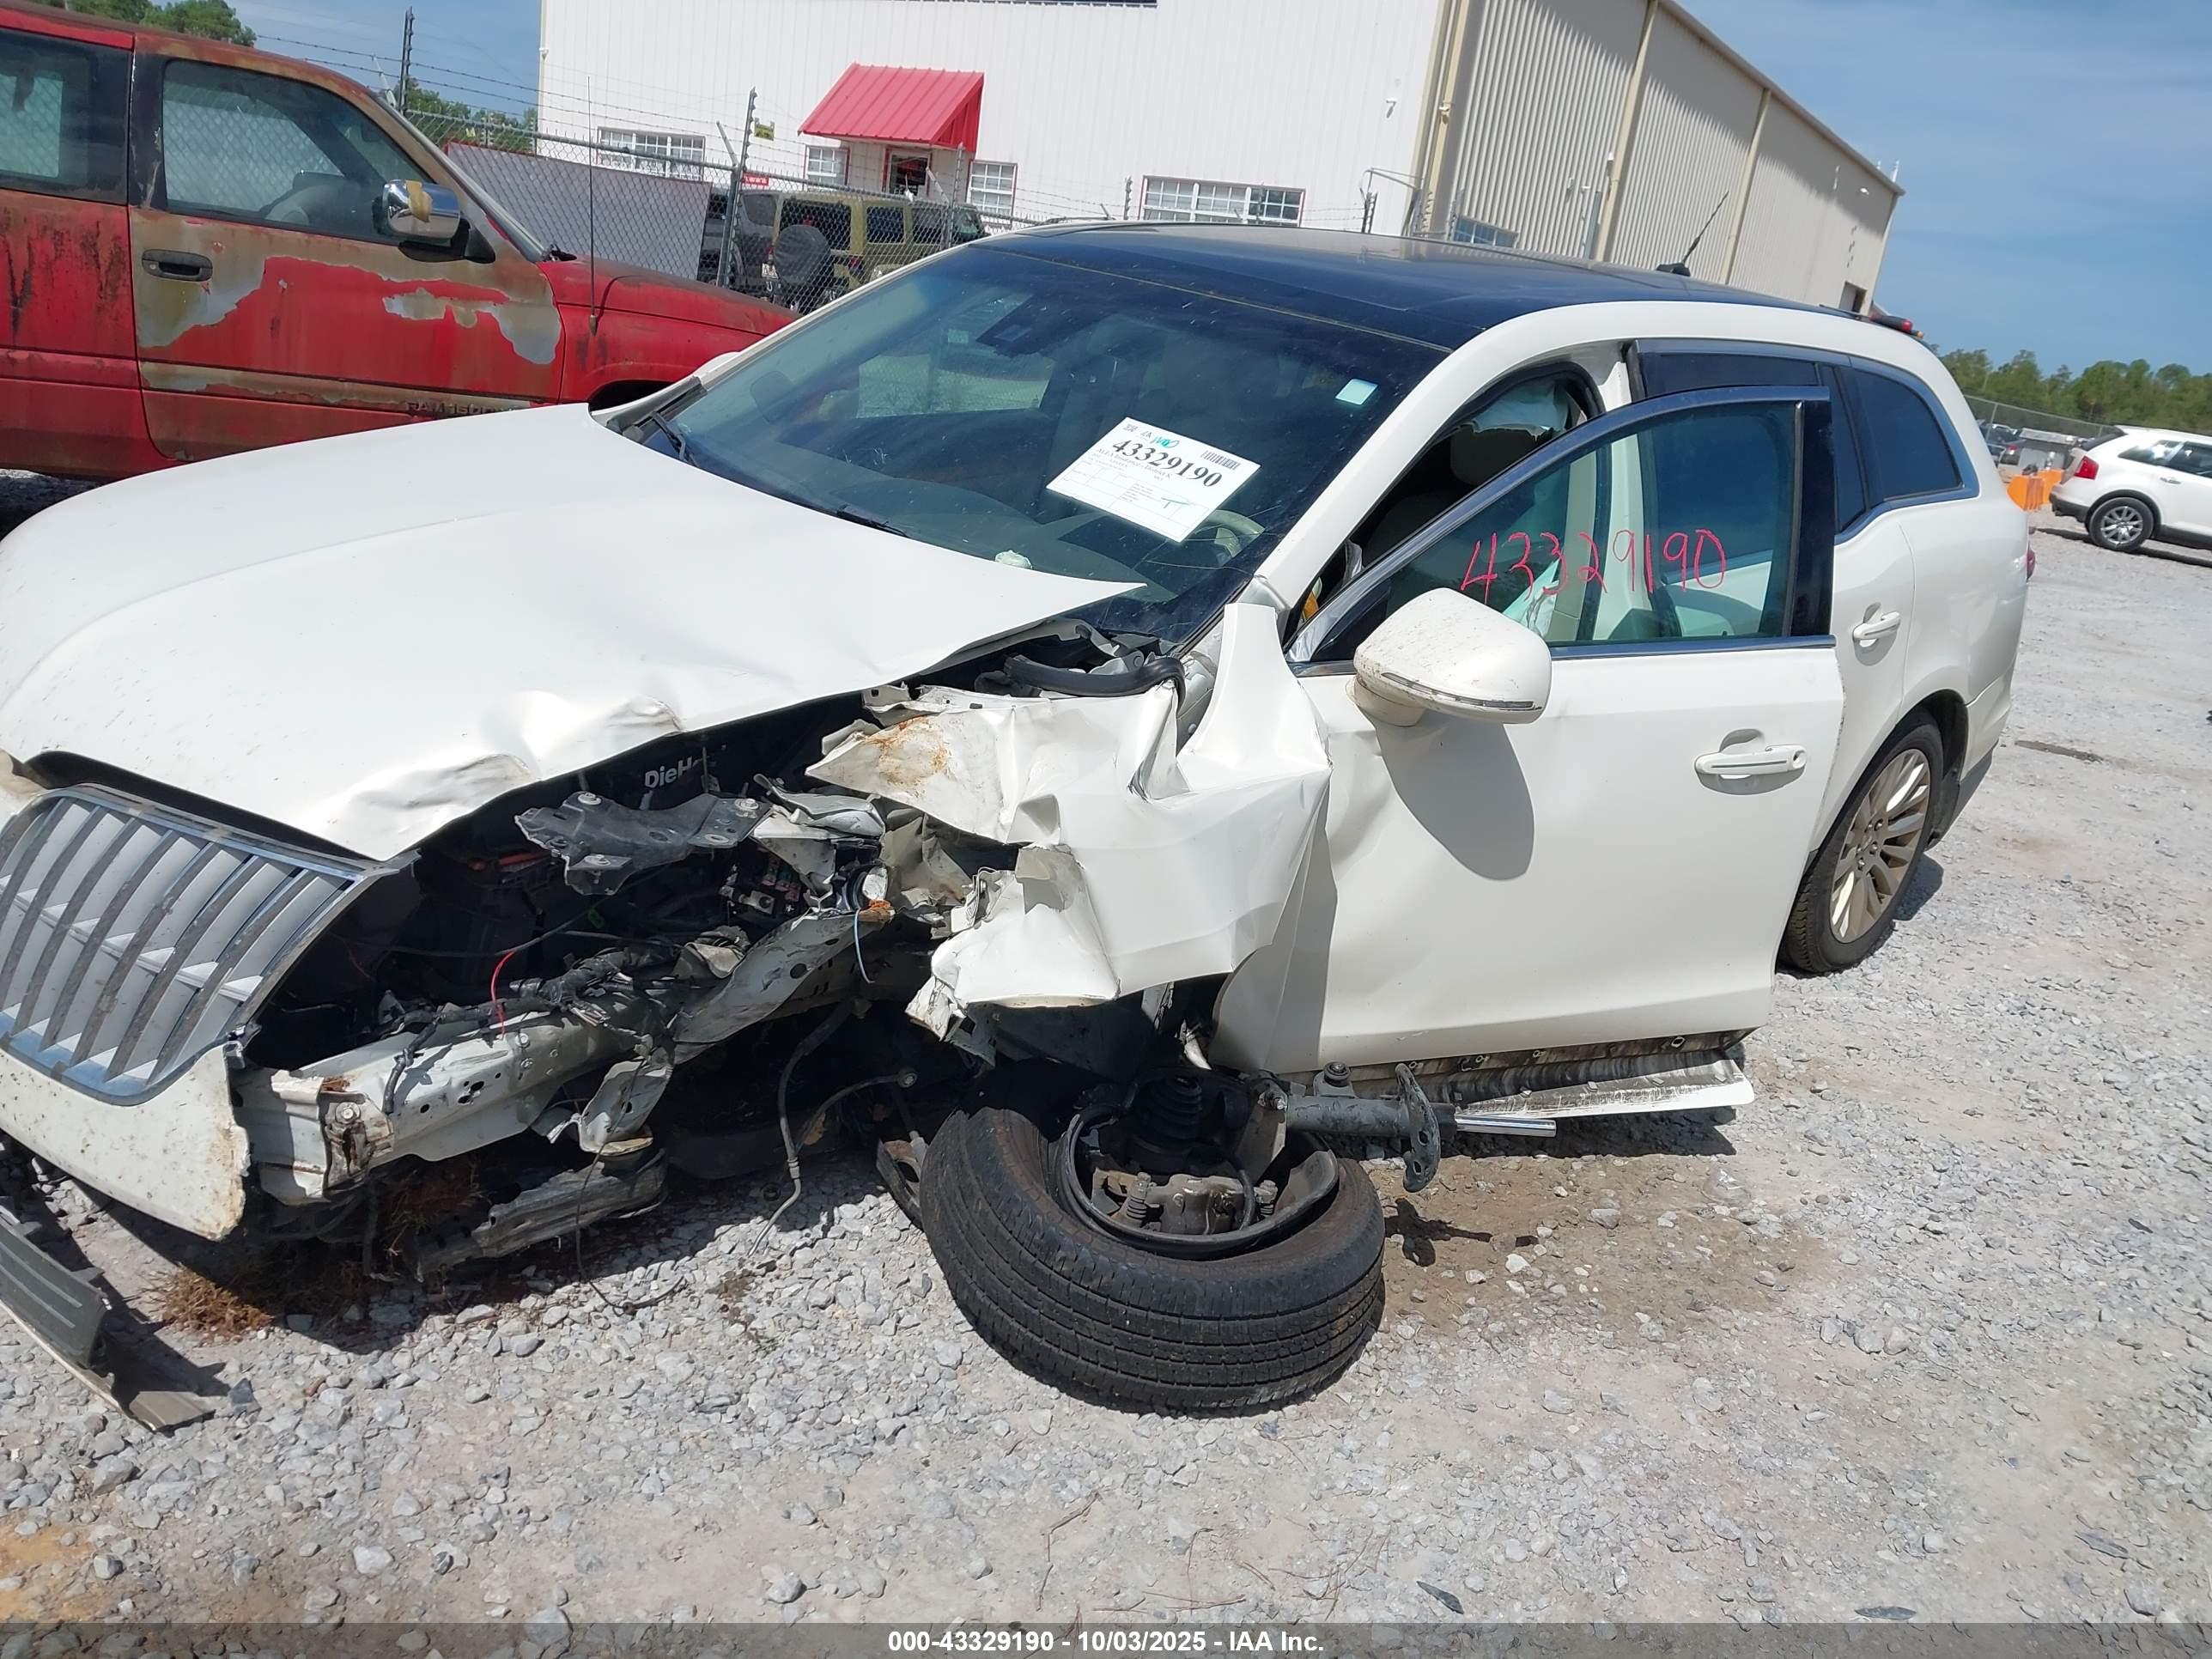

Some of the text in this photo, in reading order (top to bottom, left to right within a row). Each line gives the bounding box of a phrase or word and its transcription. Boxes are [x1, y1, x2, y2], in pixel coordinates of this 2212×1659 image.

[1112, 439, 1223, 487] 43329190
[1461, 529, 1726, 605] 43329190
[645, 756, 702, 788] DieH
